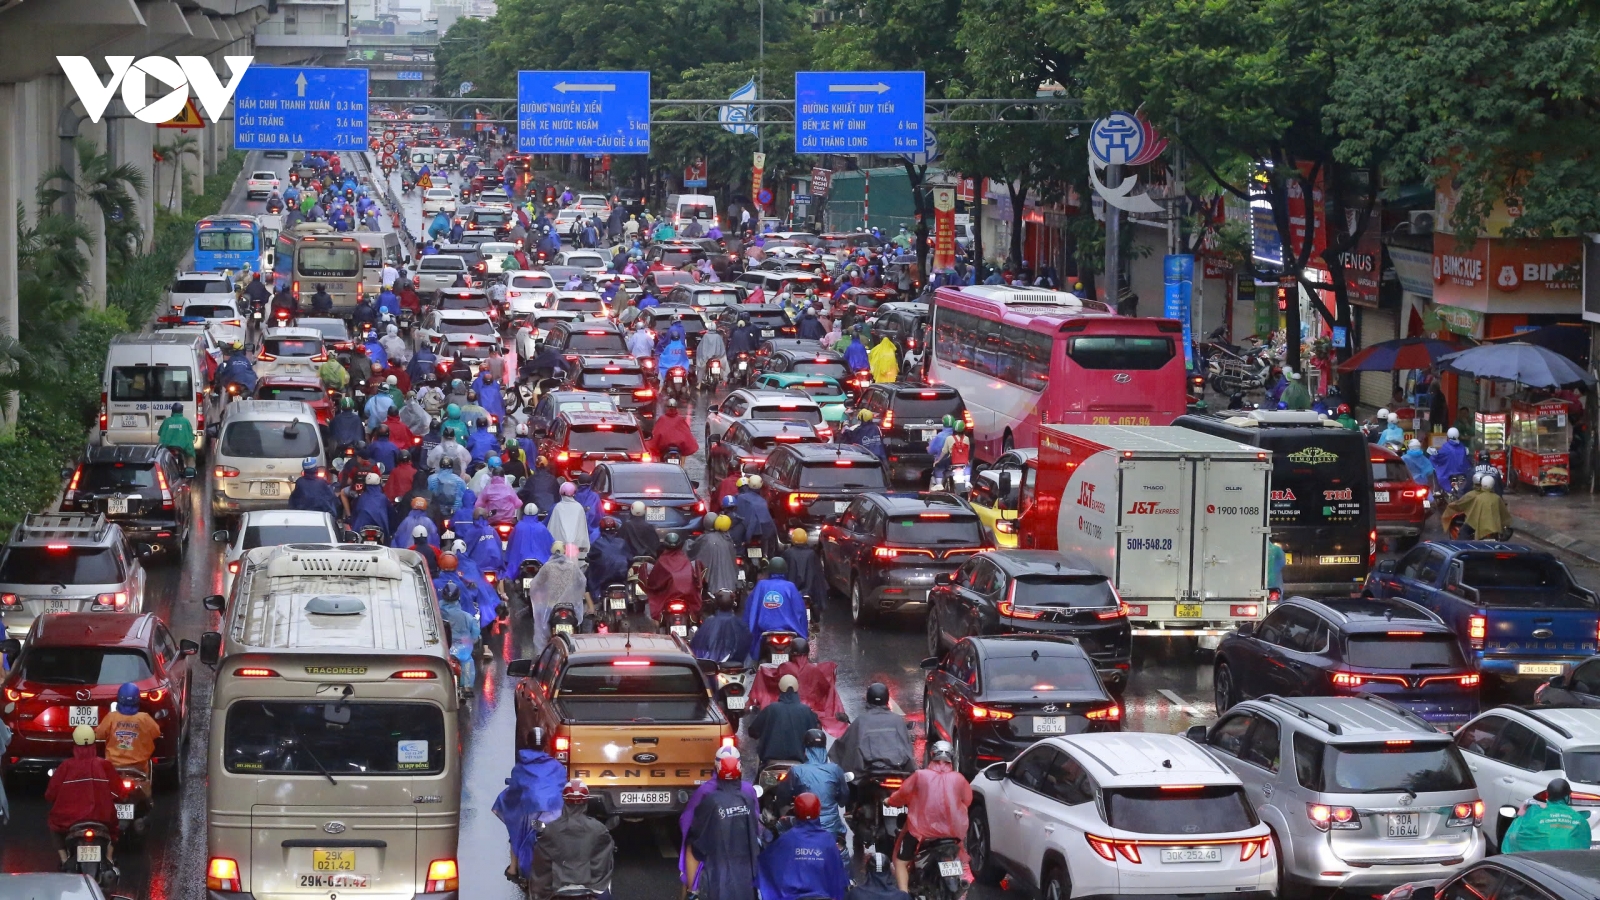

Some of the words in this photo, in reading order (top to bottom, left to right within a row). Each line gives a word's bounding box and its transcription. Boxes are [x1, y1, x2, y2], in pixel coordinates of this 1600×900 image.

[280, 99, 305, 110] THANH
[309, 98, 330, 110] XUÂN
[336, 101, 348, 110] 0.3
[351, 101, 363, 111] km
[520, 100, 548, 113] ĐƯỜNG
[550, 100, 581, 113] NGUYỄN
[802, 101, 829, 114] ĐƯỜNG
[831, 101, 856, 114] KHUẤT
[859, 104, 874, 114] DUY
[877, 100, 895, 114] TIẾN
[336, 117, 348, 127] 3.6
[351, 118, 363, 127] km
[520, 117, 536, 130] BẾN
[540, 120, 550, 130] XE
[552, 118, 574, 130] NƯỚC
[629, 120, 635, 130] 5
[636, 120, 649, 130] km
[802, 117, 818, 130] BẾN
[820, 120, 830, 130] XE
[833, 118, 845, 130] MỸ
[848, 118, 866, 130] ĐÌNH
[898, 120, 904, 130] 6
[905, 120, 918, 130] km
[239, 130, 255, 143] NÚT
[258, 133, 276, 143] GIAO
[279, 133, 290, 143] BA
[292, 133, 303, 144] LA
[351, 134, 363, 144] km
[520, 136, 536, 147] CAO
[538, 133, 553, 147] TỐC
[555, 134, 575, 147] PHÁP
[628, 136, 634, 147] 6
[636, 136, 649, 147] km
[847, 136, 868, 147] LONG
[893, 136, 903, 147] 14
[905, 136, 918, 147] km
[1338, 252, 1373, 272] VENUS
[1443, 254, 1483, 281] BINGXUE
[1127, 501, 1161, 515] J&T
[1217, 506, 1238, 515] 1900
[1240, 506, 1260, 516] 1088
[1126, 538, 1173, 551] 50H-548.28
[766, 594, 780, 603] 4G
[1488, 641, 1595, 651] RANGER
[76, 706, 92, 716] 30G
[1036, 724, 1062, 732] 650.14
[574, 769, 714, 778] RANGER
[621, 793, 670, 803] 29H-468.85
[1395, 815, 1412, 825] 30A
[1389, 825, 1418, 836] 616.44
[325, 851, 343, 860] 29K
[795, 848, 814, 856] BIDV
[1166, 850, 1217, 861] 30K-252.48
[317, 861, 351, 870] 021.42
